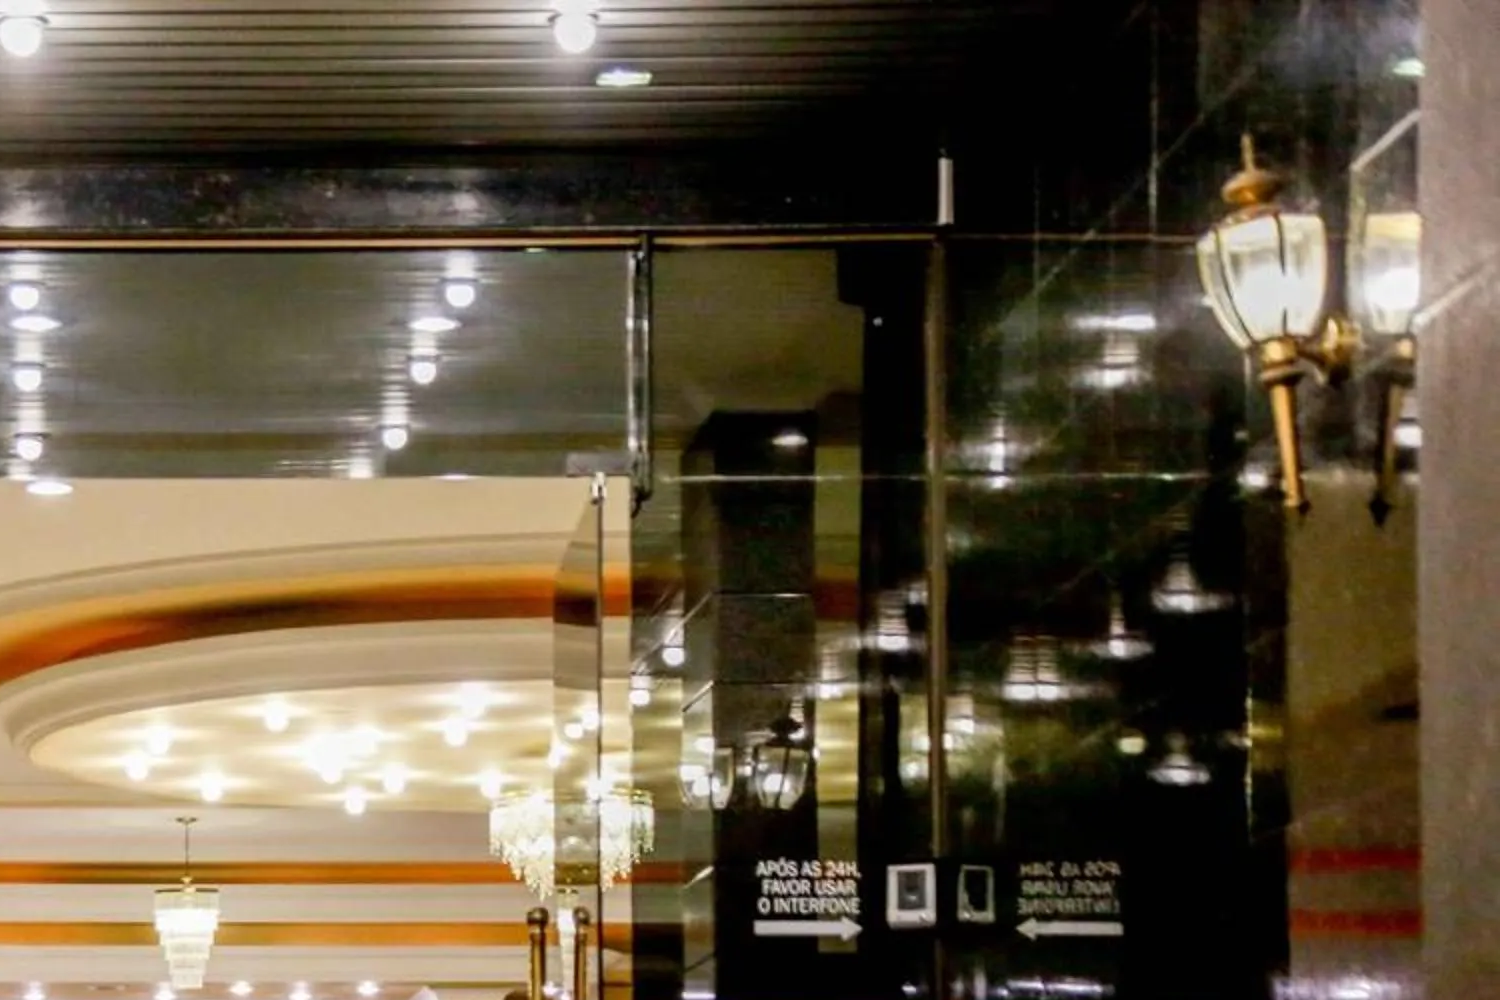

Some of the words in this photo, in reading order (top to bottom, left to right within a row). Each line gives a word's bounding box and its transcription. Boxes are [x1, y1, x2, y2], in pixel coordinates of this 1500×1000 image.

[756, 857, 799, 878] APÓS
[801, 860, 822, 877] AS
[761, 879, 811, 896] FAVOR
[814, 879, 857, 896] USAR
[757, 897, 771, 915] O
[773, 897, 861, 914] INTERFONE
